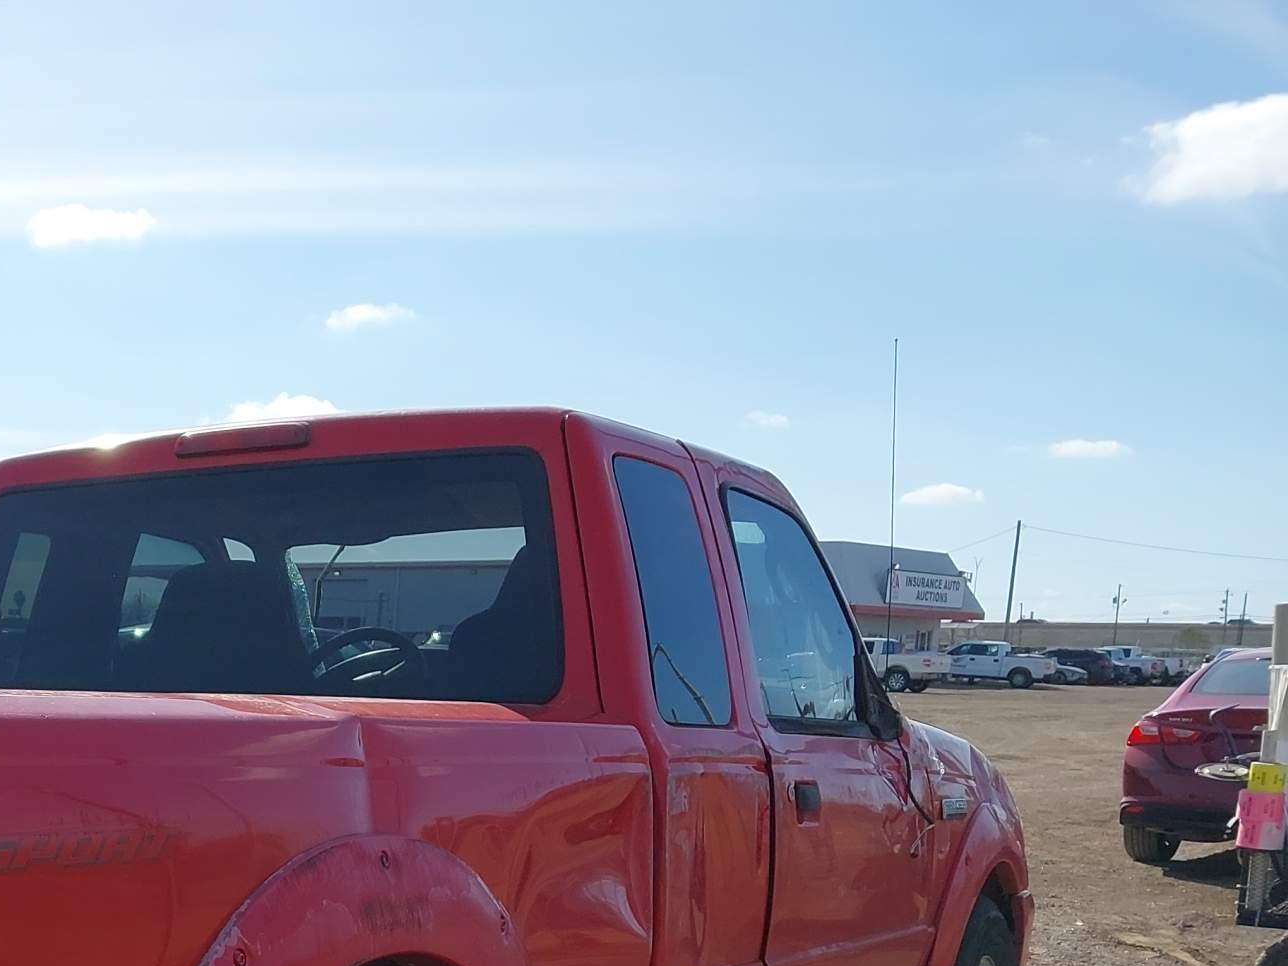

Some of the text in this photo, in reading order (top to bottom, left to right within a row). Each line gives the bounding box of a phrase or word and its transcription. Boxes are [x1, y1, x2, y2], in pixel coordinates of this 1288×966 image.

[905, 575, 943, 590] INSURANCE
[943, 580, 961, 591] AUTO
[915, 590, 948, 602] AUCTIONS
